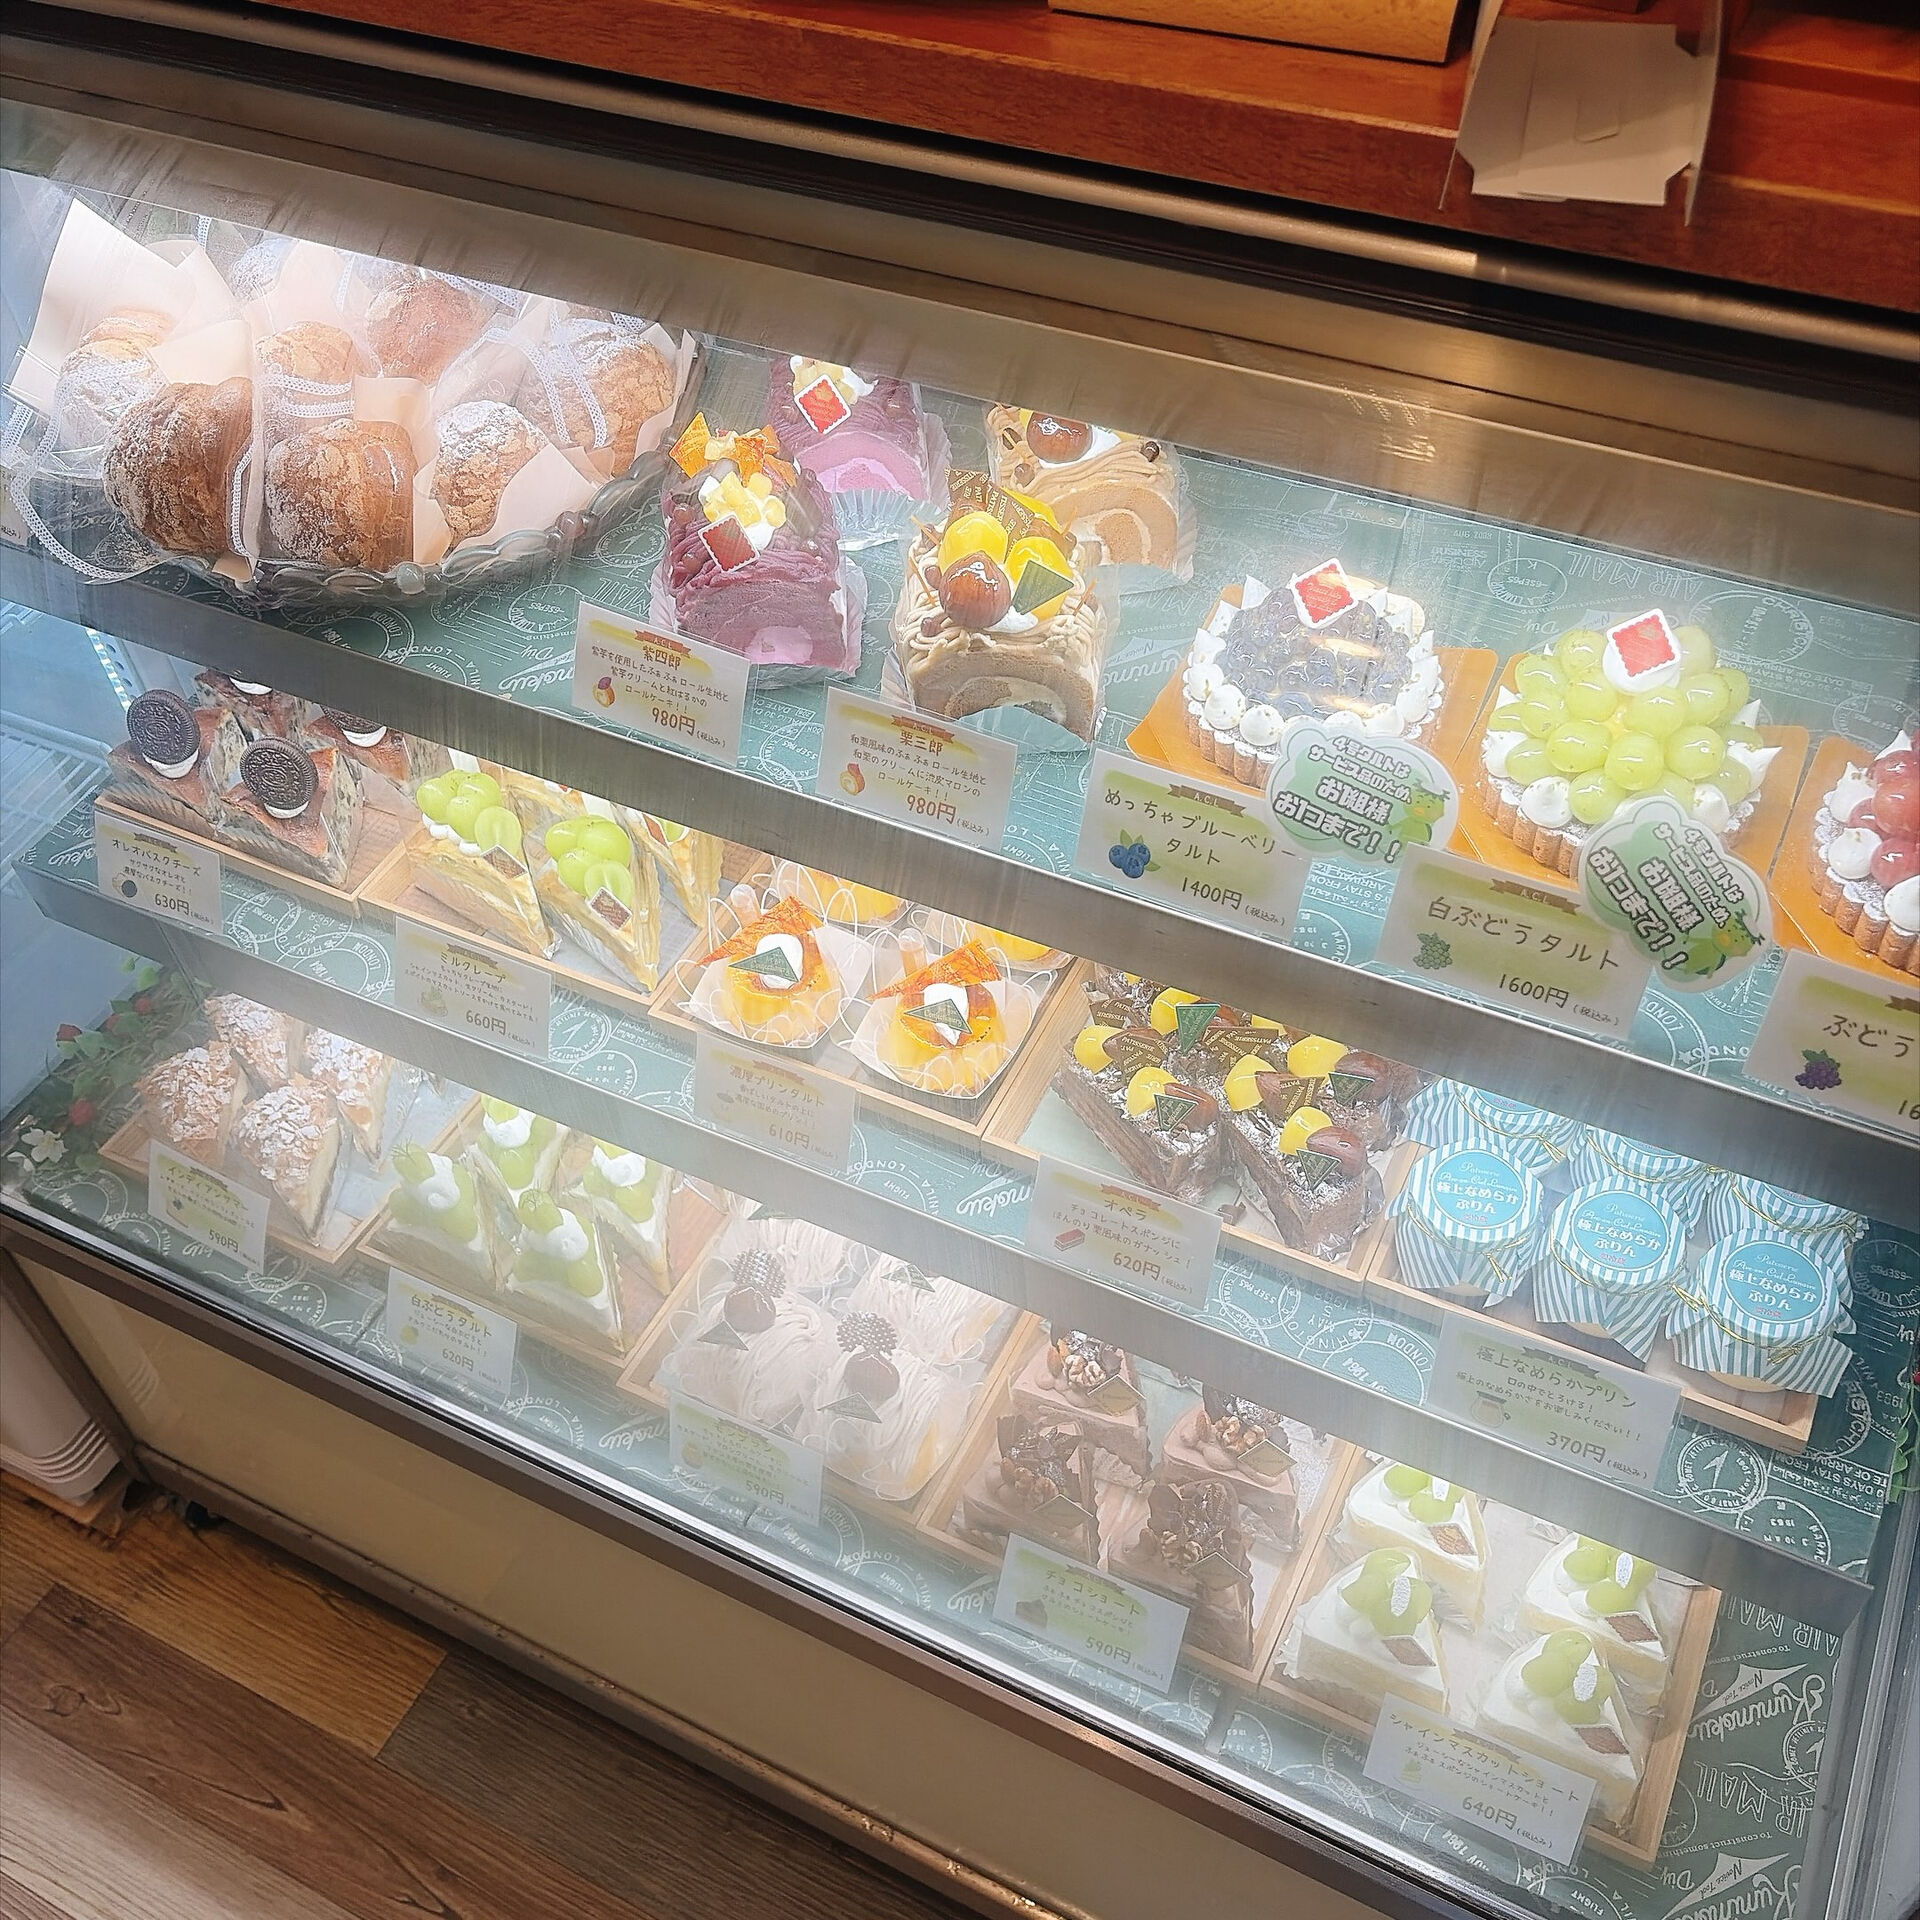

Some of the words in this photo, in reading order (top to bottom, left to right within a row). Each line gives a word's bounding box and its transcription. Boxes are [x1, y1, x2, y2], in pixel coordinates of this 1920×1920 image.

[642, 645, 682, 671] 紫四郎
[652, 708, 696, 736] 980円
[900, 732, 943, 756] 栗三郎
[1332, 736, 1411, 779] 4号タルトは
[907, 795, 956, 824] 980円
[1105, 788, 1295, 857] めっちゃブルーベリー
[112, 839, 202, 876] オレオバスクチーズ
[1167, 838, 1221, 865] タルト
[155, 894, 189, 916] 630円
[1182, 877, 1242, 910] 1400円
[1428, 896, 1618, 970] 白ぶどうタルト
[440, 952, 507, 983] ミルクレープ
[1500, 974, 1569, 1008] 1600円
[466, 1010, 507, 1035] 660円
[1822, 1014, 1914, 1057] ぶどう
[769, 1124, 810, 1149] 610円
[1436, 1182, 1519, 1205] 極上なめらか
[1456, 1199, 1496, 1213] ぷりん
[1104, 1200, 1147, 1221] オペラ
[1071, 1203, 1180, 1249] チョコレートスポンジに
[1577, 1219, 1661, 1251] 極上なめらか
[1594, 1238, 1636, 1257] ぷりん
[1114, 1253, 1161, 1281] 620円
[1729, 1269, 1816, 1302] 極上なめらか
[1748, 1290, 1791, 1310] ぷりん
[411, 1294, 492, 1337] 白ぶどうタルト
[442, 1348, 474, 1371] 620円
[1476, 1346, 1637, 1408] 極上なめらかプリン
[1546, 1431, 1606, 1464] 370円
[746, 1480, 784, 1504] 590円
[1047, 1570, 1140, 1616] チョコショート
[1085, 1636, 1131, 1665] 590円
[1390, 1713, 1579, 1803] シャインマスカットショート
[1462, 1797, 1518, 1831] 640円
